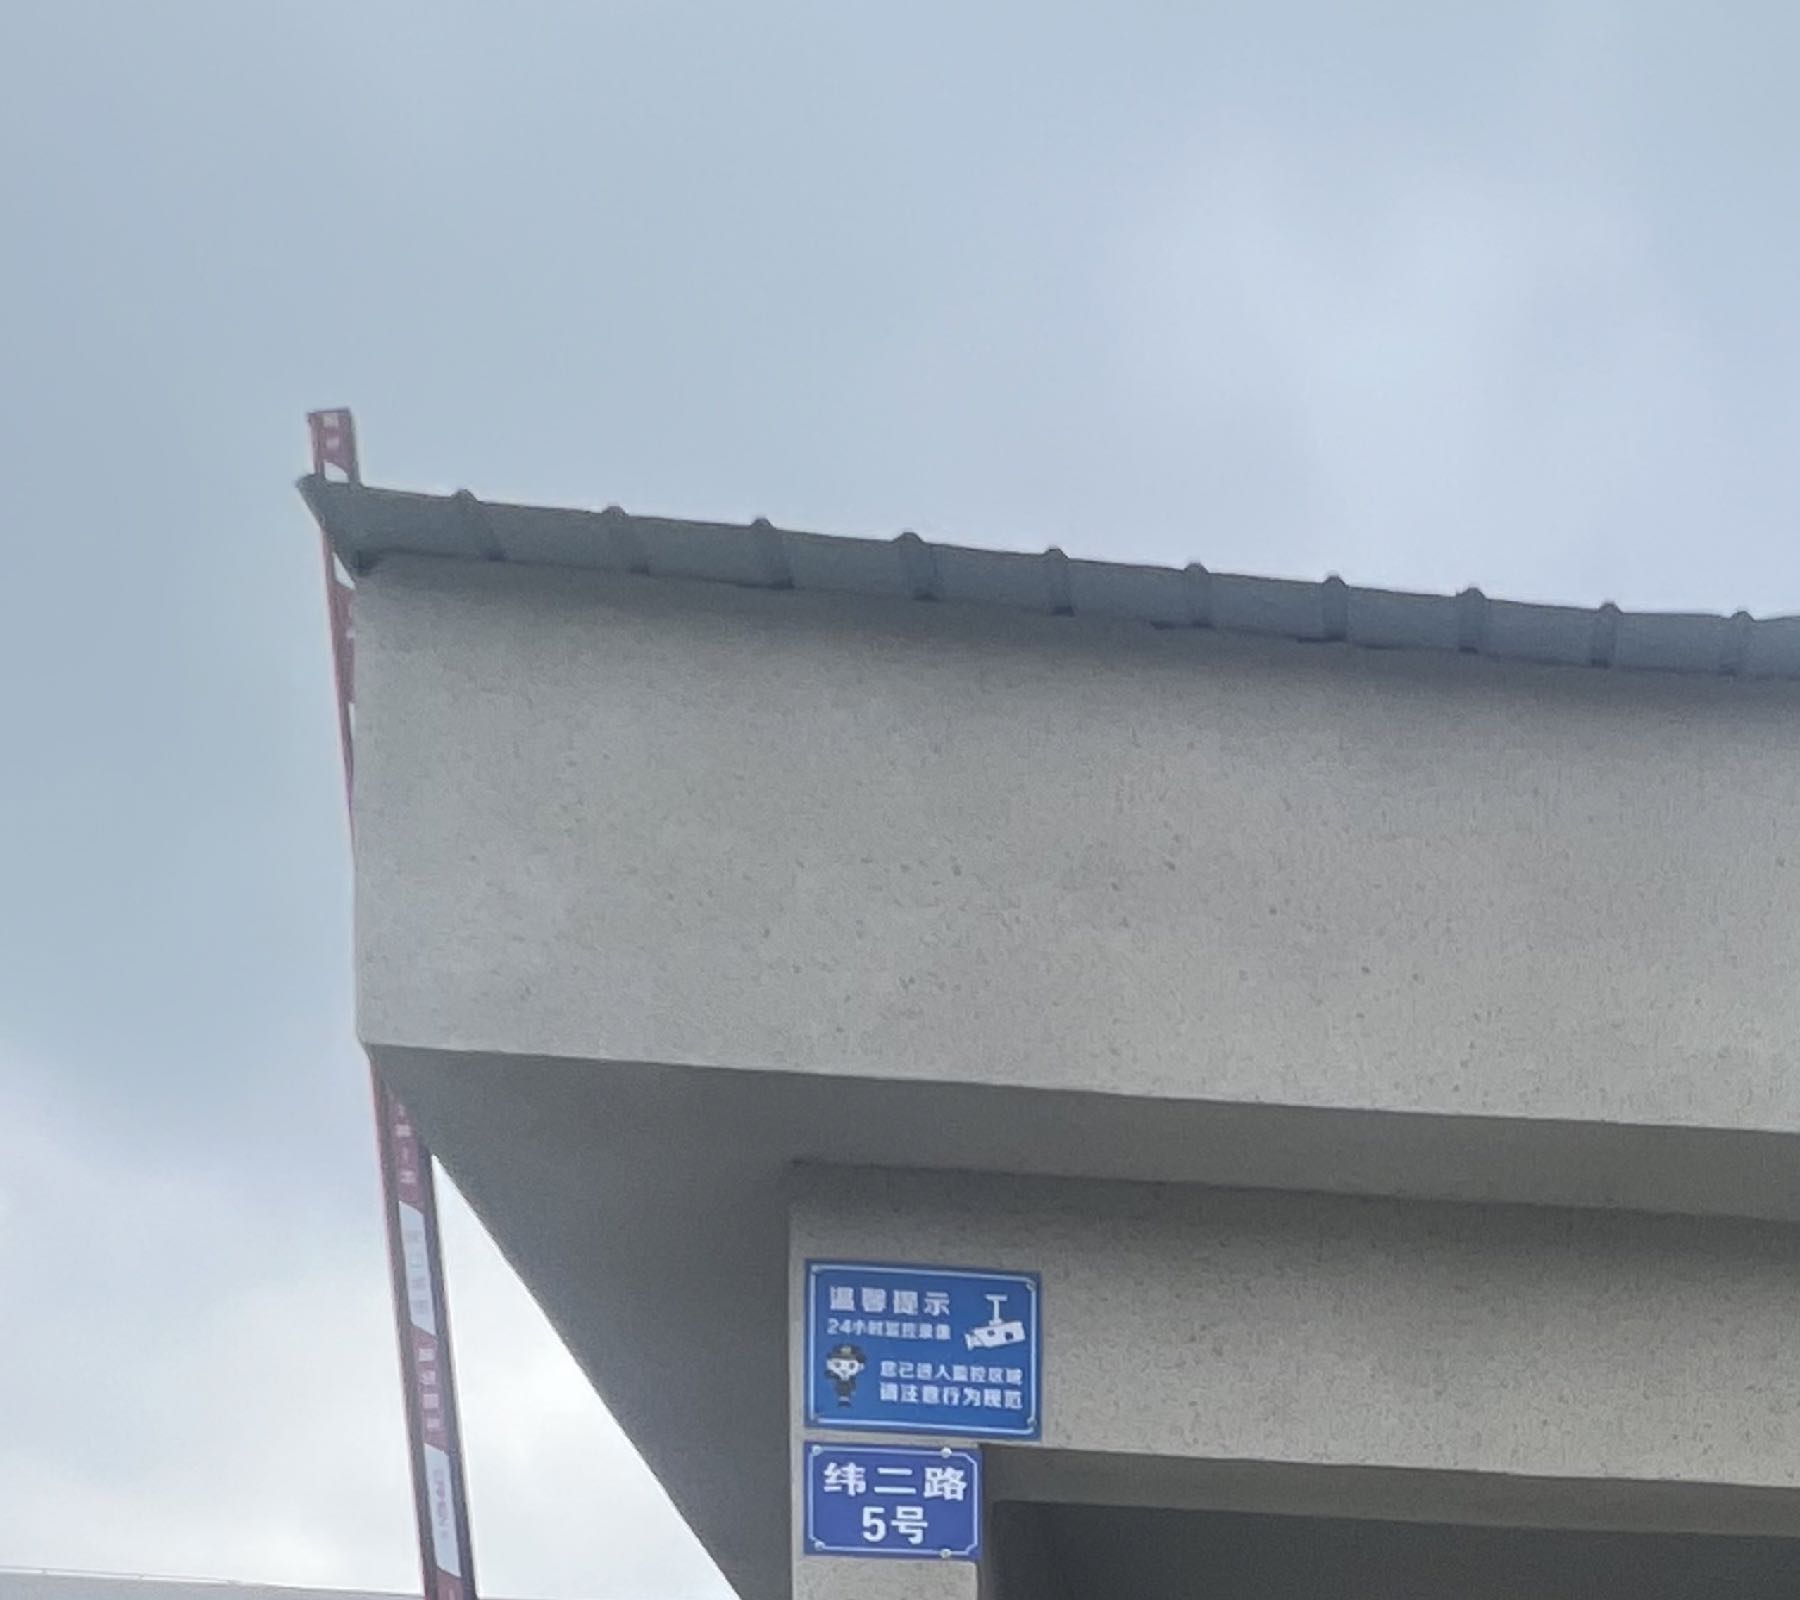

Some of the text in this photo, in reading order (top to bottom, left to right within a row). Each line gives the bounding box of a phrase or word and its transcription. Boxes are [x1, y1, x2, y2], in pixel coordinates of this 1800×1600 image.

[829, 1286, 951, 1317] 温馨提示
[823, 1462, 967, 1501] 纬二路
[861, 1505, 929, 1545] 5号
